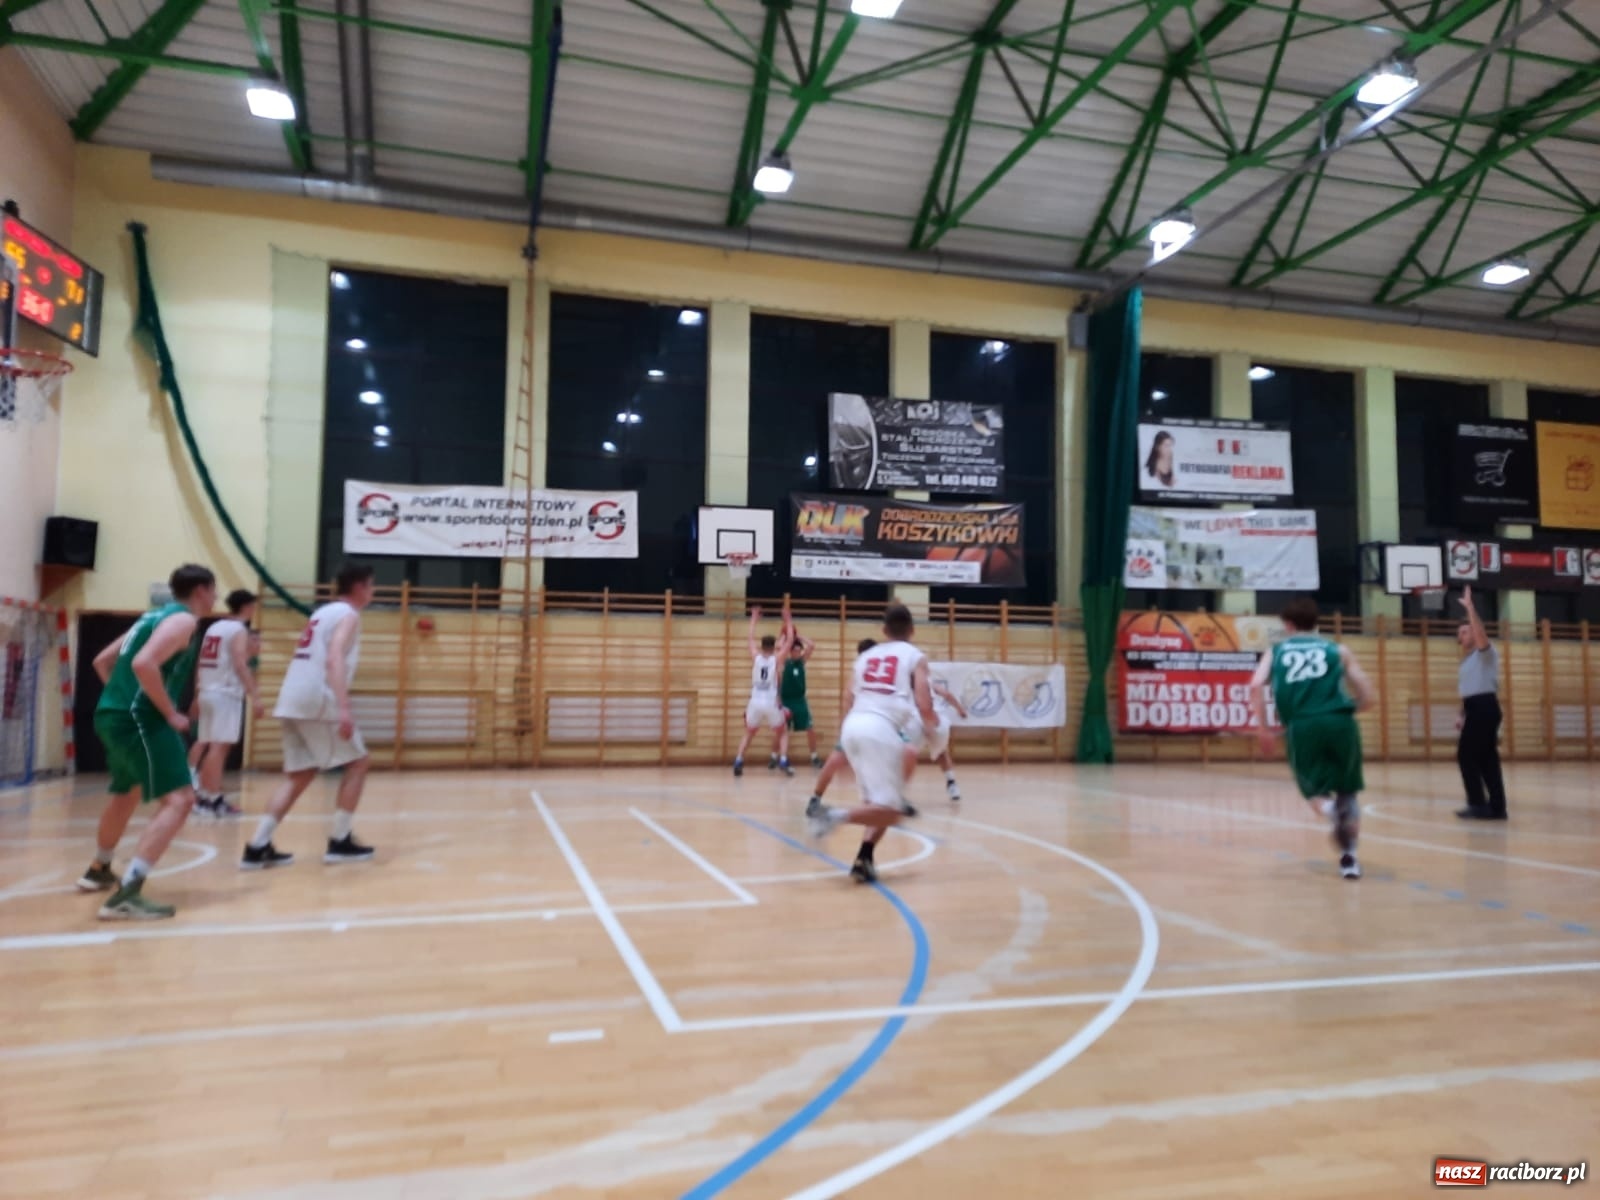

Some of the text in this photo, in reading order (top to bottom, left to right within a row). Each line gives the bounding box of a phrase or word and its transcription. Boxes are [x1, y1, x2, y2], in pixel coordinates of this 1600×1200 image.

[411, 495, 469, 510] PORTAL
[863, 655, 898, 686] 23
[1282, 649, 1328, 684] 23
[1127, 683, 1212, 702] MIASTO
